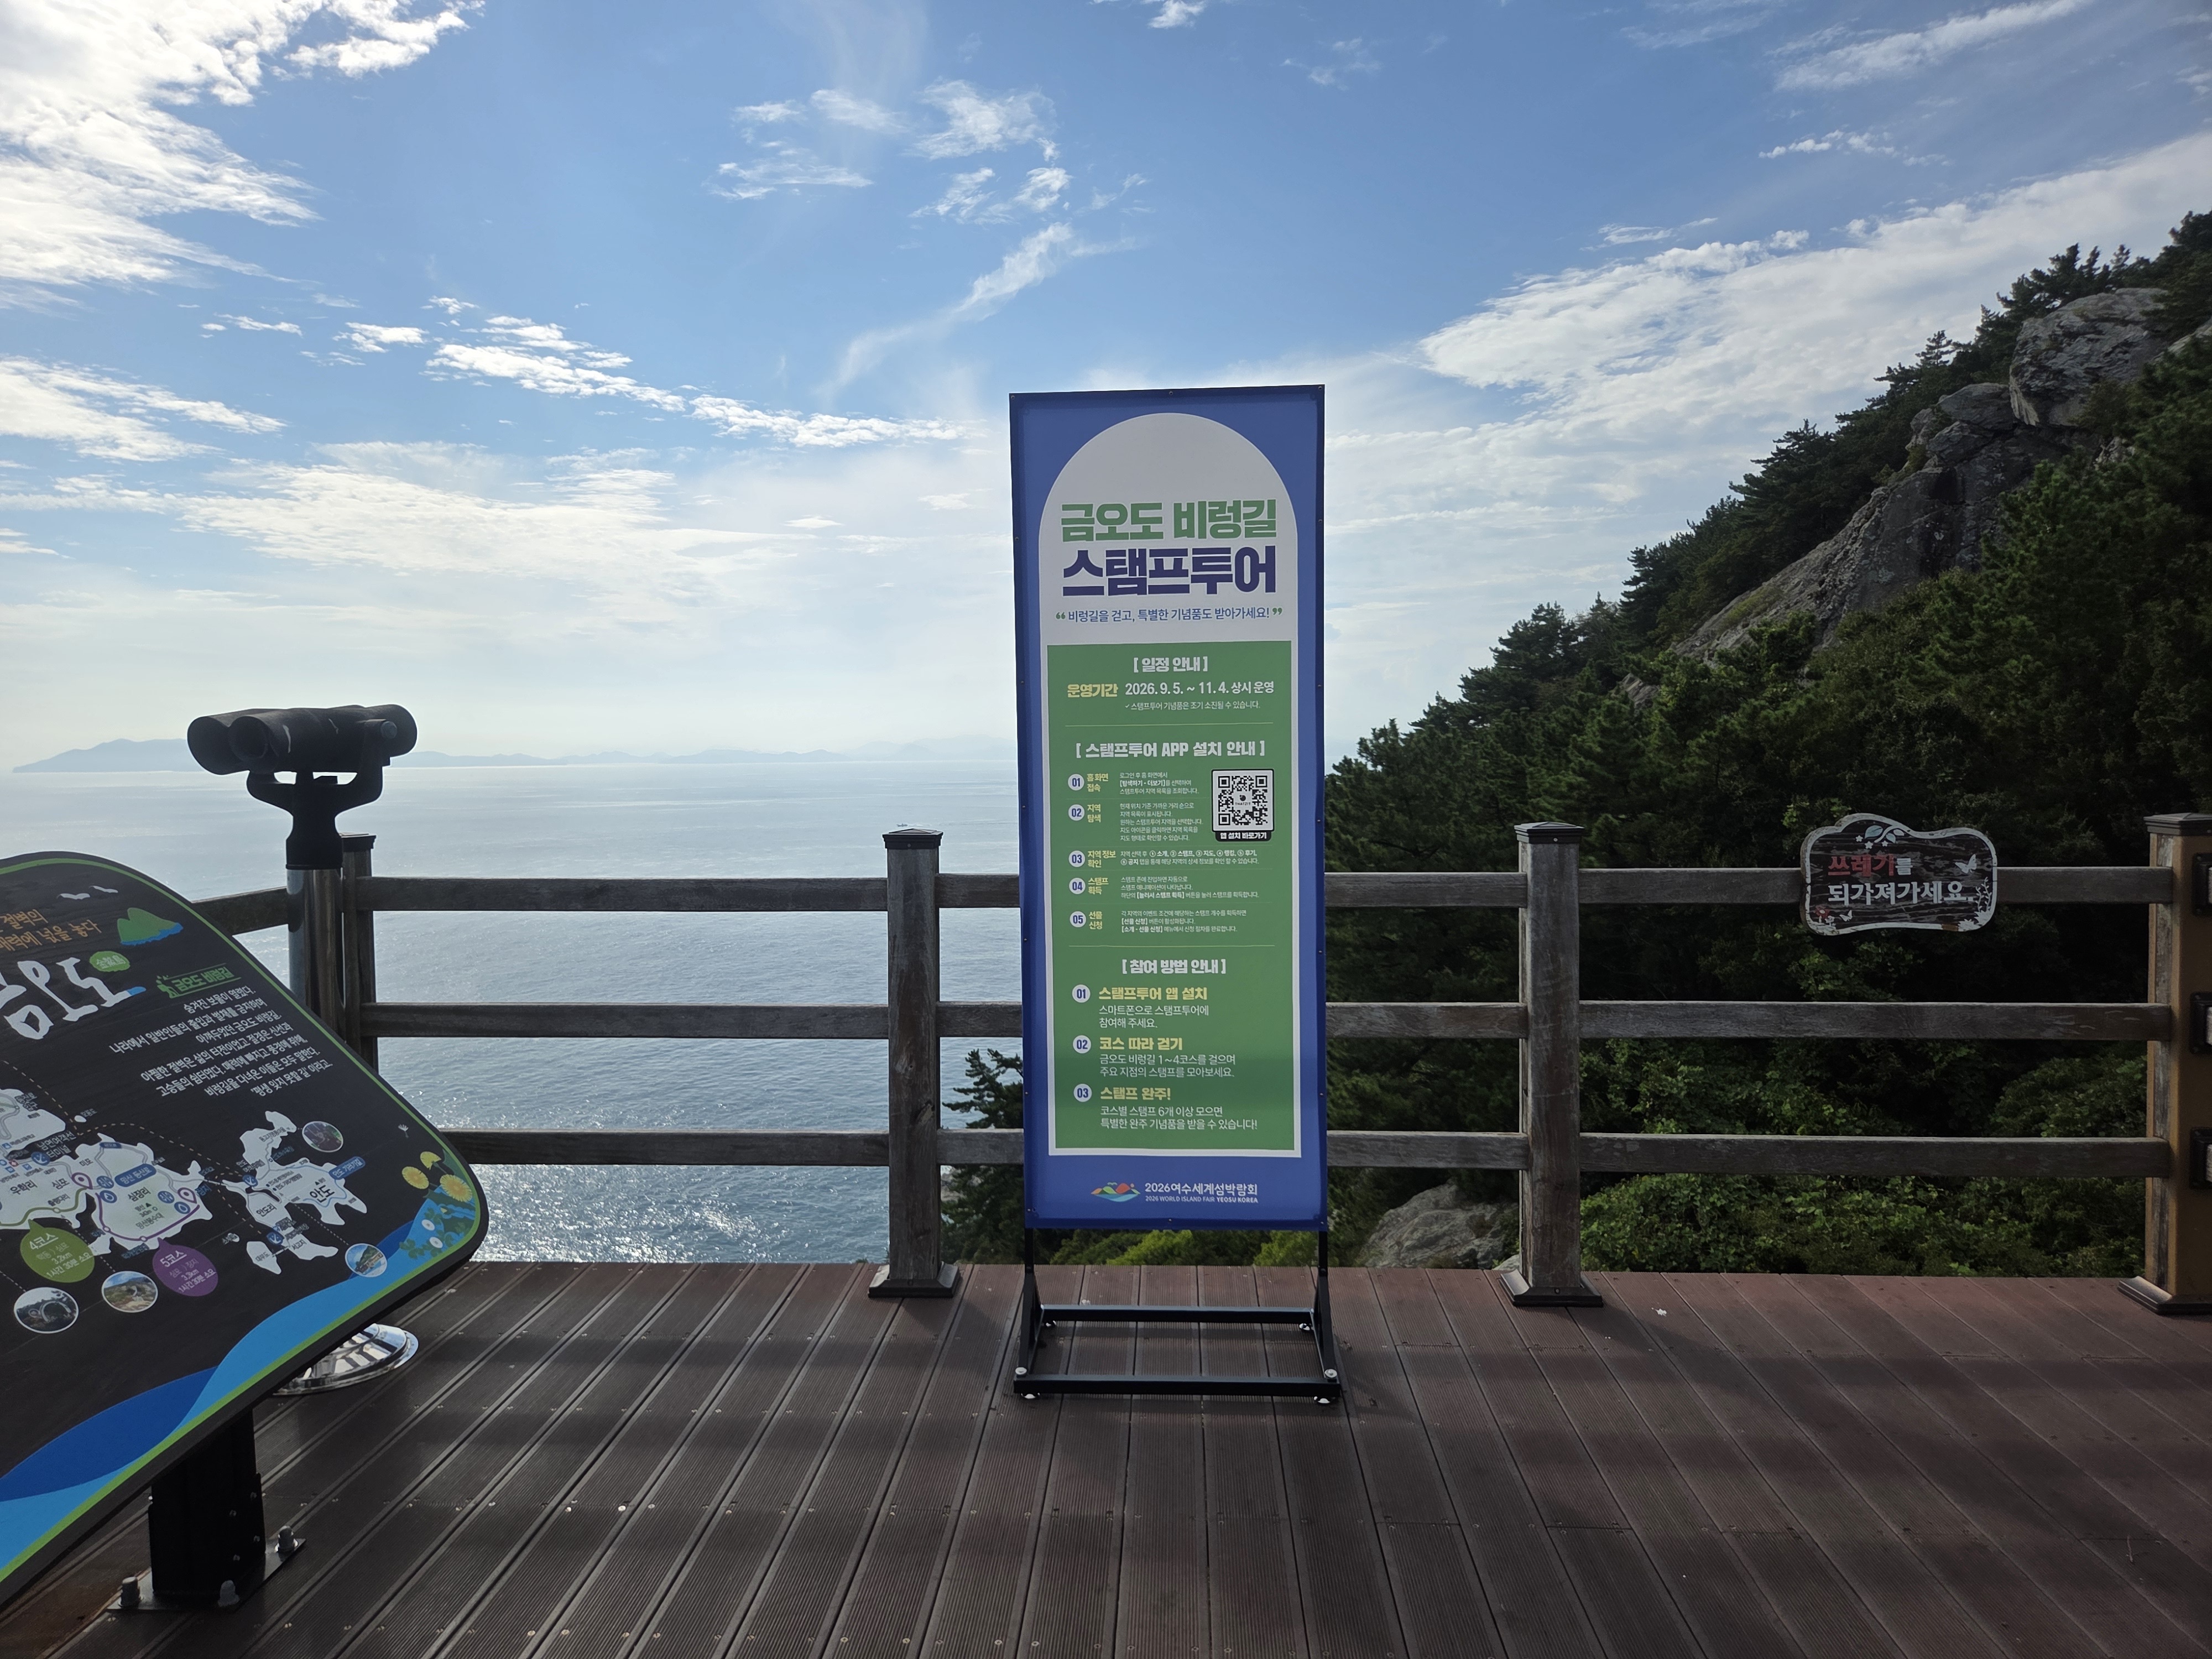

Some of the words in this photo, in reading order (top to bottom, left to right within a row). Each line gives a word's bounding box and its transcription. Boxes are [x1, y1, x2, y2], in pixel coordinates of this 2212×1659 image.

[1061, 503, 1164, 542] 금오도
[1173, 499, 1276, 539] 비렁길
[1063, 545, 1276, 596] 스탬프투어
[1068, 611, 1109, 622] 비렁길을
[1112, 610, 1135, 622] 걷고,
[1138, 609, 1168, 621] 특별한
[1171, 608, 1212, 621] 기념품도
[1215, 608, 1269, 620] 받아가세요!
[1067, 684, 1118, 698] 운영기간
[1232, 681, 1251, 694] 상시
[1254, 681, 1274, 693] 운영
[1204, 701, 1224, 709] 소진될
[1233, 701, 1260, 709] 있습니다.
[1086, 743, 1156, 758] 스탬프투어
[1162, 742, 1188, 757] APP
[1193, 741, 1222, 757] 설치
[1227, 740, 1255, 756] 안내
[1072, 778, 1081, 787] 01
[1087, 784, 1100, 792] 접속
[1072, 808, 1081, 817] 02
[1072, 854, 1082, 864] 03
[1828, 854, 1913, 877] 쓰레기를
[1072, 881, 1082, 891] 04
[1088, 878, 1109, 886] 스탬프
[1828, 881, 1974, 906] 되가져가세요.
[1073, 915, 1083, 924] 05
[1089, 921, 1103, 930] 신청
[69, 919, 102, 937] 놓다
[1130, 960, 1157, 974] 참여
[1161, 959, 1187, 974] 방법
[1191, 959, 1218, 974] 안내
[171, 975, 207, 992] 금오도
[201, 966, 234, 983] 비렁길
[1077, 989, 1086, 999] 01
[1099, 988, 1161, 1000] 스탬프투어
[1166, 987, 1177, 1000] 앱
[1182, 987, 1207, 1000] 설치
[184, 999, 210, 1014] 숨겨진
[206, 992, 233, 1006] 보물이
[1099, 1006, 1152, 1016] 스마트폰으로
[1155, 1005, 1208, 1016] 스탬프투어에
[109, 1035, 150, 1053] 나라에서
[145, 1021, 192, 1043] 일반인들의
[187, 1015, 216, 1030] 출입과
[236, 998, 268, 1014] 금지하며
[1099, 1018, 1126, 1028] 참여해
[1128, 1018, 1157, 1028] 주세요.
[196, 1022, 237, 1044] 아껴두었던
[233, 1018, 259, 1031] 금오도
[167, 1057, 197, 1073] 절벽은
[194, 1050, 214, 1064] 삶의
[210, 1038, 251, 1056] 터전이었고
[247, 1030, 273, 1044] 절경은
[270, 1022, 294, 1036] 신선과
[1077, 1040, 1088, 1049] 02
[1100, 1037, 1125, 1050] 코스
[1129, 1037, 1154, 1050] 따라
[1157, 1037, 1182, 1050] 걷기
[1100, 1055, 1126, 1064] 금오도
[1128, 1055, 1155, 1064] 비렁길
[1208, 1055, 1235, 1065] 걸으며
[156, 1077, 194, 1097] 고승들의
[190, 1065, 226, 1085] 쉼터였다.
[221, 1056, 249, 1071] 매력에
[245, 1048, 270, 1061] 빠지고
[267, 1040, 292, 1055] 풍경에
[204, 1078, 240, 1097] 비렁길을
[236, 1069, 263, 1084] 다녀온
[259, 1061, 284, 1074] 이들은
[280, 1054, 297, 1066] 모두
[295, 1046, 320, 1061] 말한다.
[1100, 1068, 1118, 1077] 주요
[1120, 1067, 1146, 1077] 지점의
[1149, 1067, 1185, 1078] 스탬프를
[1187, 1067, 1234, 1077] 모아보세요.
[269, 1078, 288, 1090] 잊지
[284, 1071, 302, 1084] 못할
[1077, 1088, 1088, 1098] 03
[1100, 1087, 1138, 1100] 스탬프
[1141, 1088, 1171, 1100] 완주!
[1100, 1107, 1126, 1116] 코스별
[1129, 1107, 1156, 1116] 스탬프
[1159, 1106, 1173, 1117] 6개
[1176, 1106, 1193, 1116] 이상
[1196, 1106, 1222, 1117] 모으면
[1100, 1119, 1127, 1129] 특별한
[1129, 1119, 1147, 1129] 완주
[1150, 1119, 1185, 1129] 기념품을
[1187, 1119, 1205, 1129] 받을
[1207, 1119, 1216, 1129] 수
[1218, 1119, 1258, 1129] 있습니다!
[37, 1131, 76, 1151] 남면여객선
[46, 1145, 71, 1157] 터미널
[10, 1180, 38, 1195] 우학리
[52, 1178, 70, 1190] 심포
[1145, 1183, 1258, 1196] 2026여수세계섬박람회
[128, 1187, 151, 1202] 심장리
[310, 1185, 335, 1203] 안도
[256, 1203, 277, 1217] 안도리
[29, 1233, 59, 1250] 4코스
[46, 1267, 65, 1278] 1시간
[63, 1259, 80, 1270] 30분
[79, 1252, 94, 1262] 소요
[160, 1250, 187, 1267] 5코스
